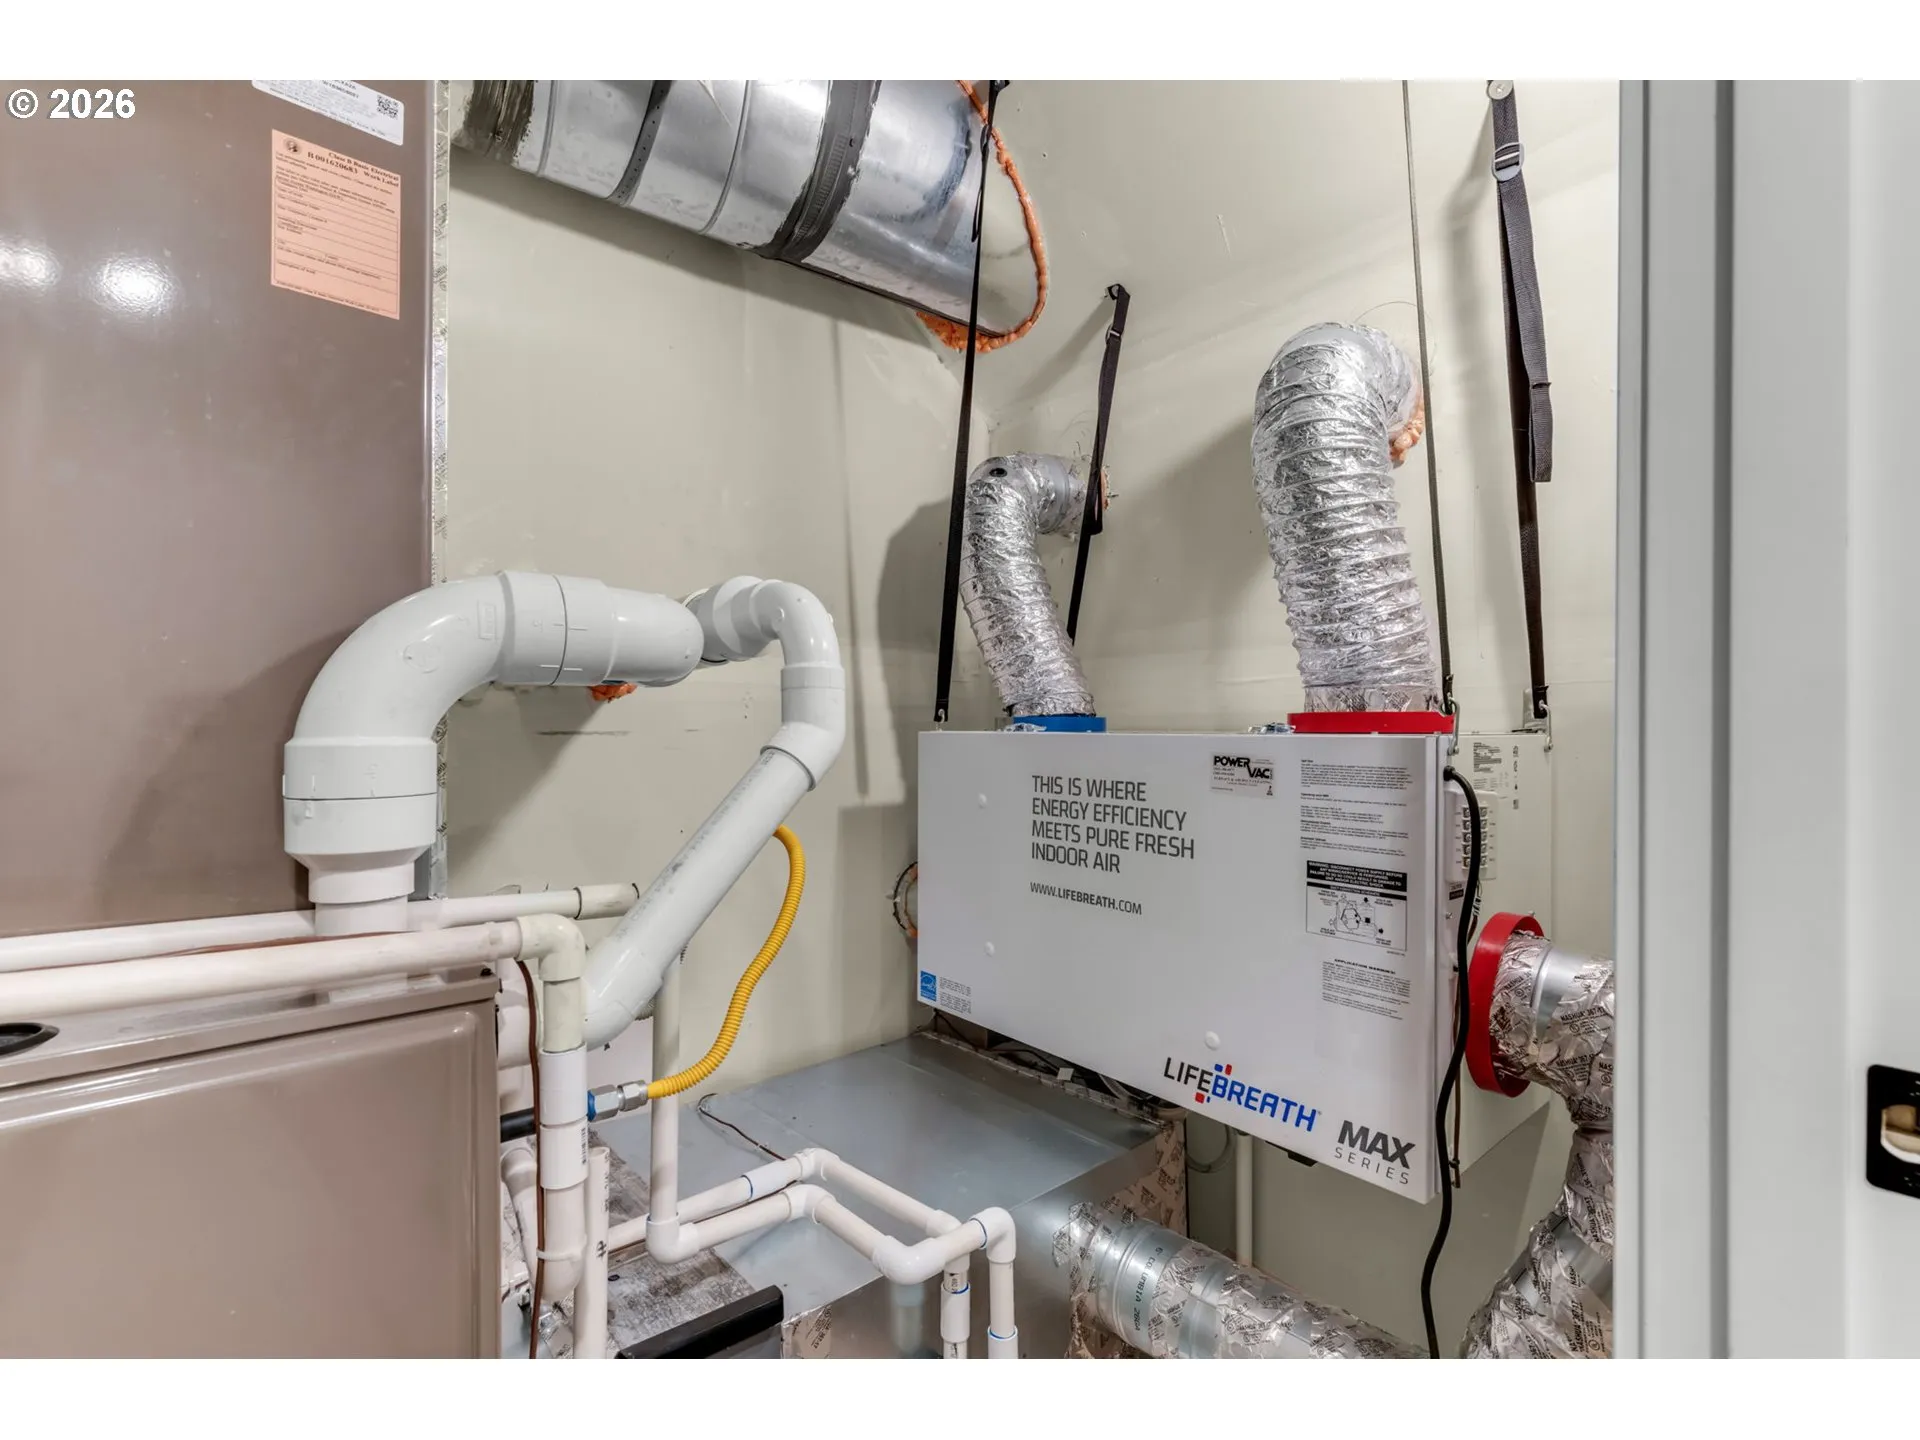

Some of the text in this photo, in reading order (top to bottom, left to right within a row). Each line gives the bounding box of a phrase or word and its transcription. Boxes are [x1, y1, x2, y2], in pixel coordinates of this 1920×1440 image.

[1213, 755, 1251, 768] POWER
[1247, 765, 1270, 780] VAC
[1032, 775, 1147, 802] THIS IS WHERE
[1032, 797, 1187, 832] ENERGY EFFICIENCY
[1031, 819, 1195, 860] MEETS PURE FRESH
[1031, 842, 1121, 874] INDOOR AIR
[1030, 881, 1143, 916] WWW.LIFEBREATH.COM
[1163, 1057, 1318, 1132] LIFEBREATH
[1337, 1120, 1416, 1169] MAX
[1334, 1147, 1410, 1185] SERIES
